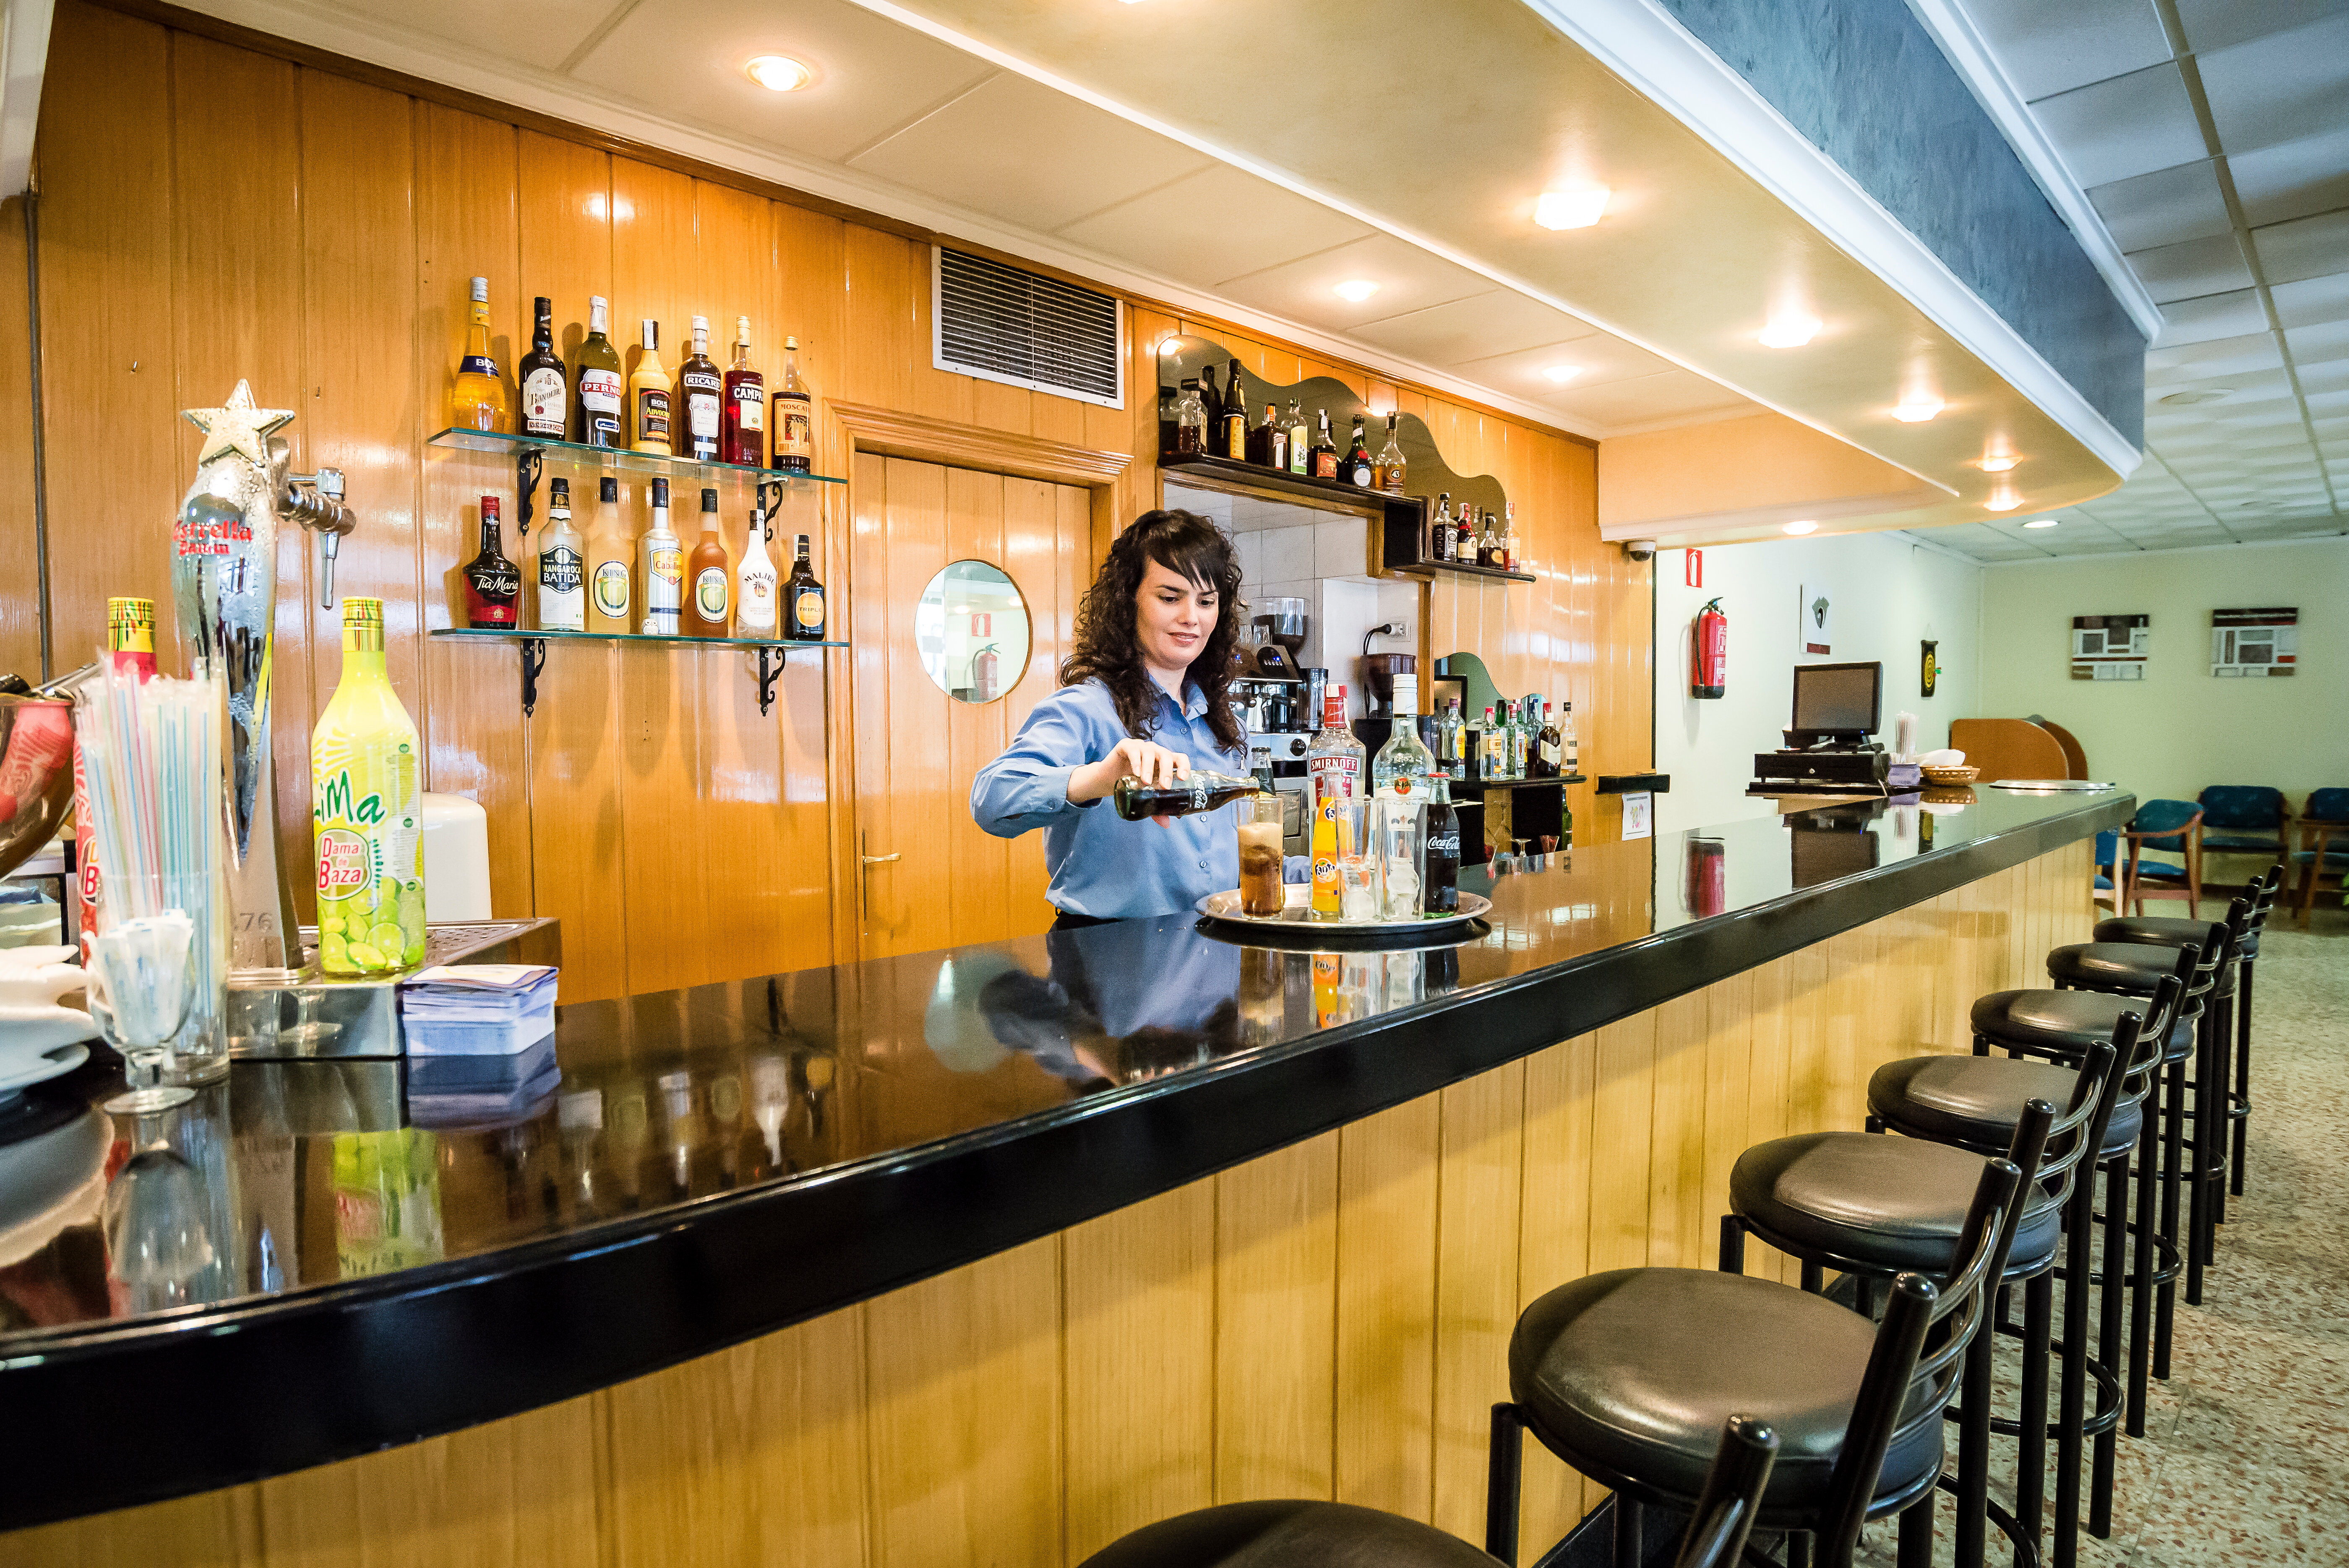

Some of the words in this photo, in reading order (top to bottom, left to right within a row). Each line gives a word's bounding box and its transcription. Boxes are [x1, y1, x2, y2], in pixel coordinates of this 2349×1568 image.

[688, 377, 720, 388] RICARD
[544, 573, 581, 583] BATIDA
[602, 569, 626, 578] KING
[744, 572, 775, 585] MALIBU
[474, 575, 494, 590] Tia
[703, 576, 725, 585] KING
[1311, 758, 1357, 770] SMIRNOFF
[323, 838, 360, 857] Dama
[319, 860, 362, 888] Baza
